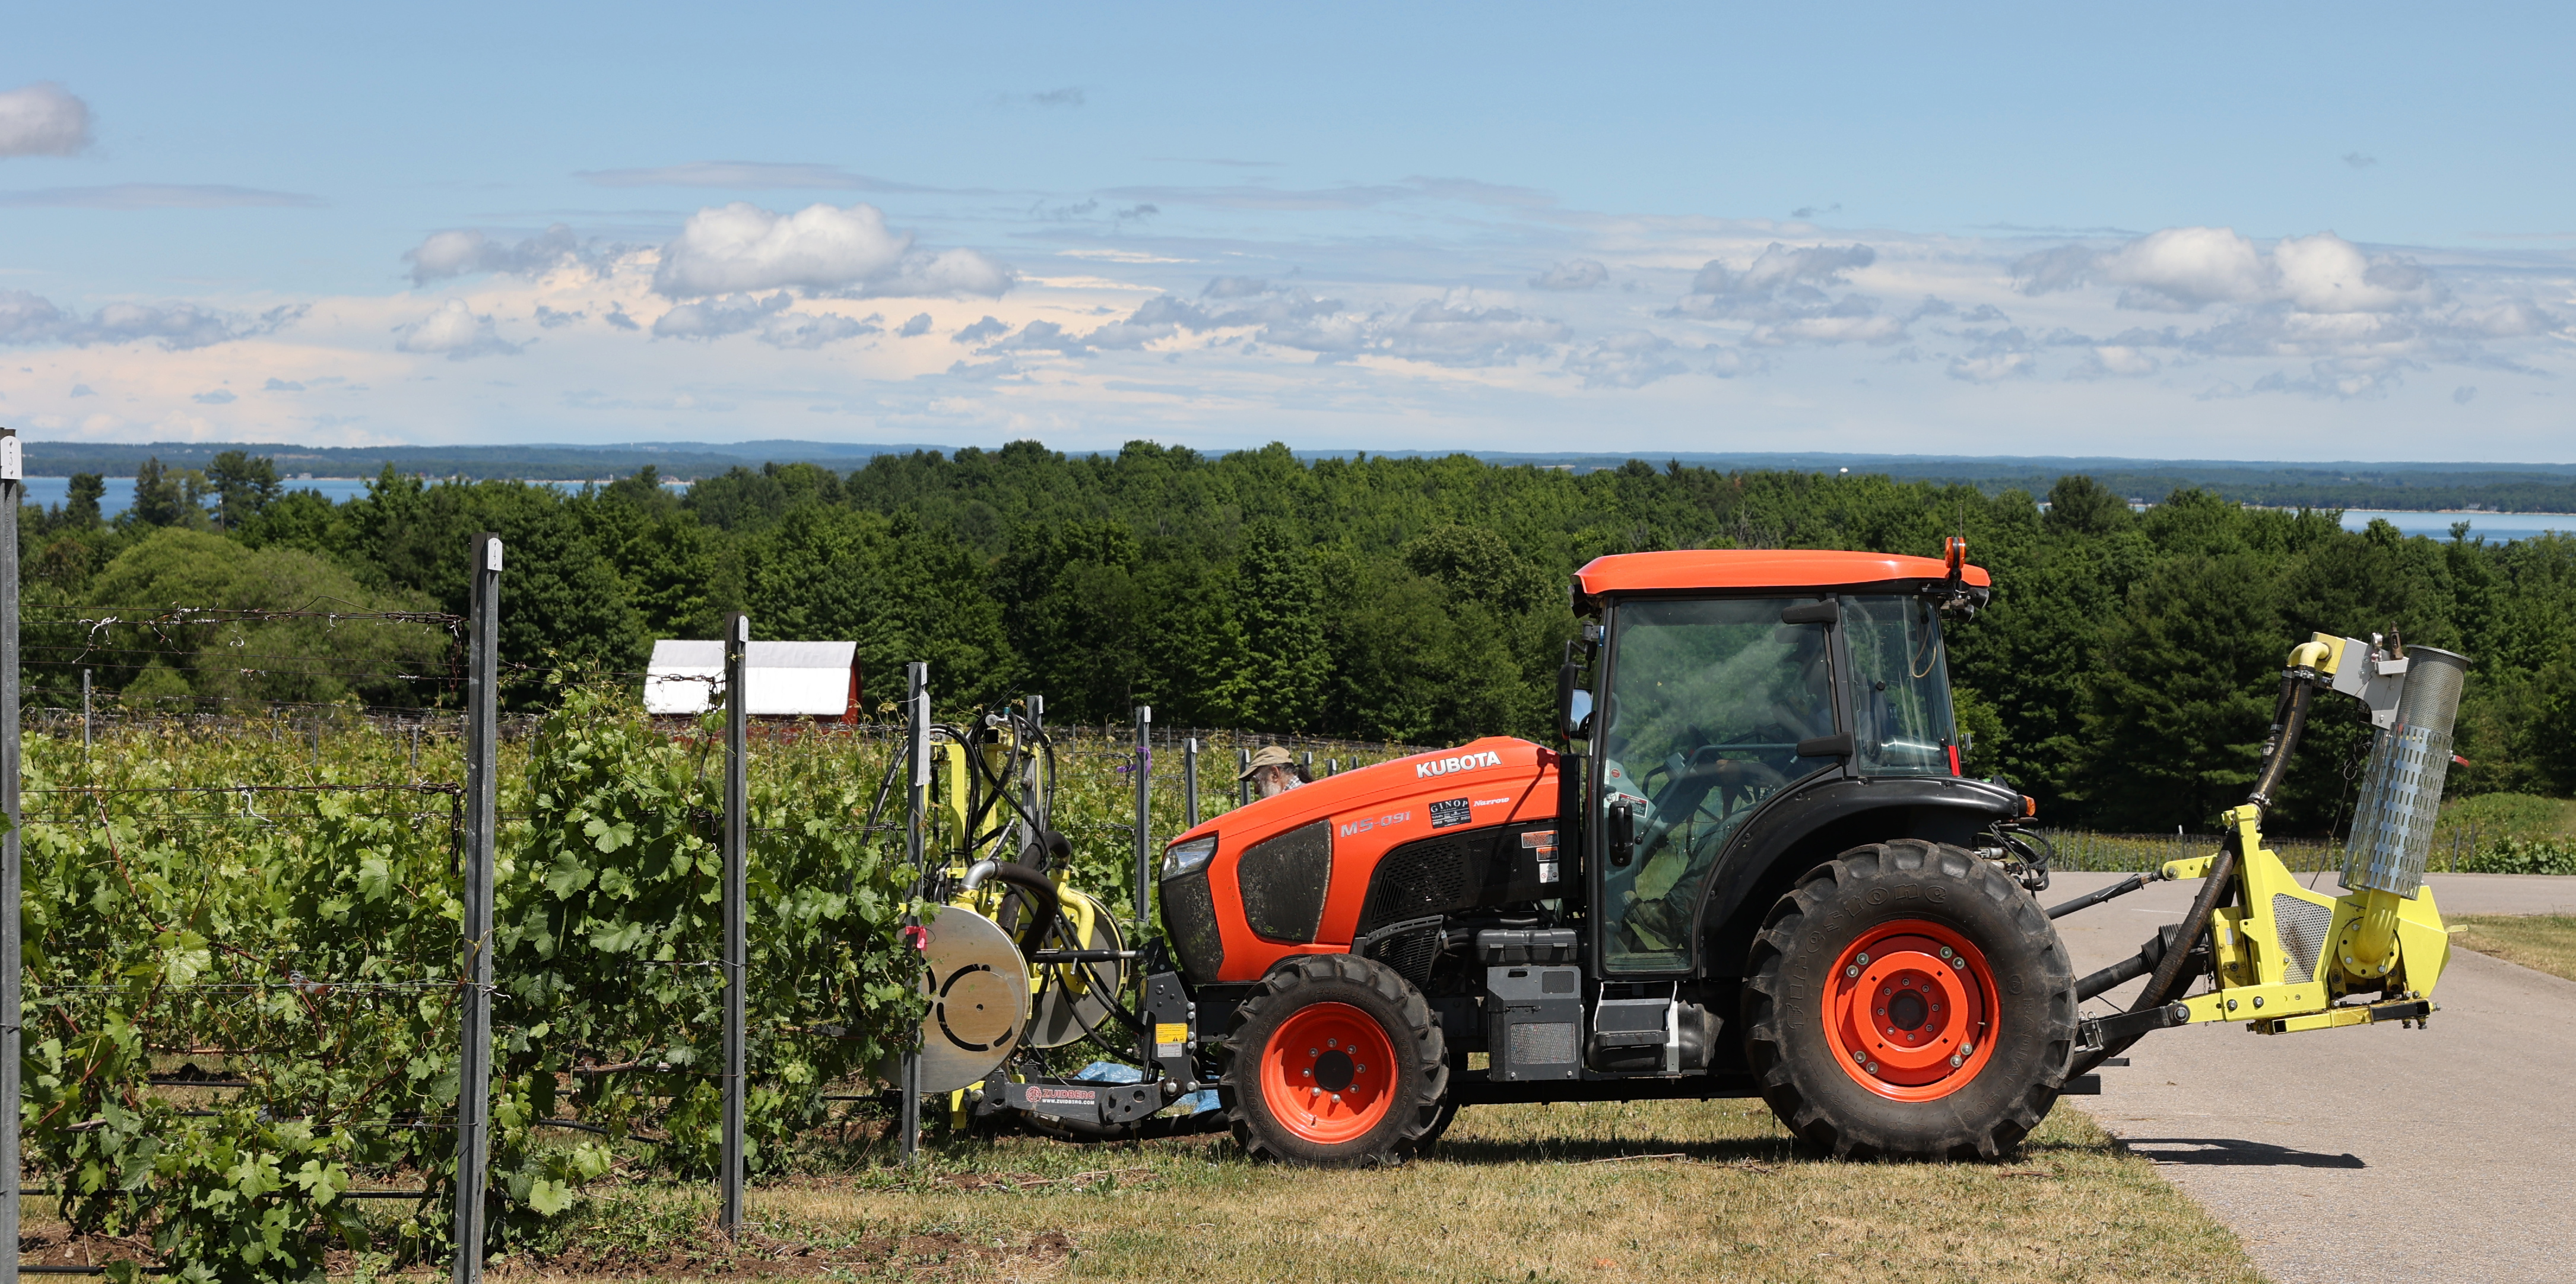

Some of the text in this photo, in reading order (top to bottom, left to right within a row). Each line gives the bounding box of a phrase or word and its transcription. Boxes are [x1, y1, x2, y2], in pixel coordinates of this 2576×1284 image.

[1416, 751, 1502, 779] KUBOTA
[1430, 800, 1468, 813] GINOP
[1473, 797, 1510, 807] Narrow
[1340, 811, 1410, 838] M5-091
[1785, 883, 1947, 1029] Firestone
[1042, 1089, 1095, 1099] ZUIDBERG
